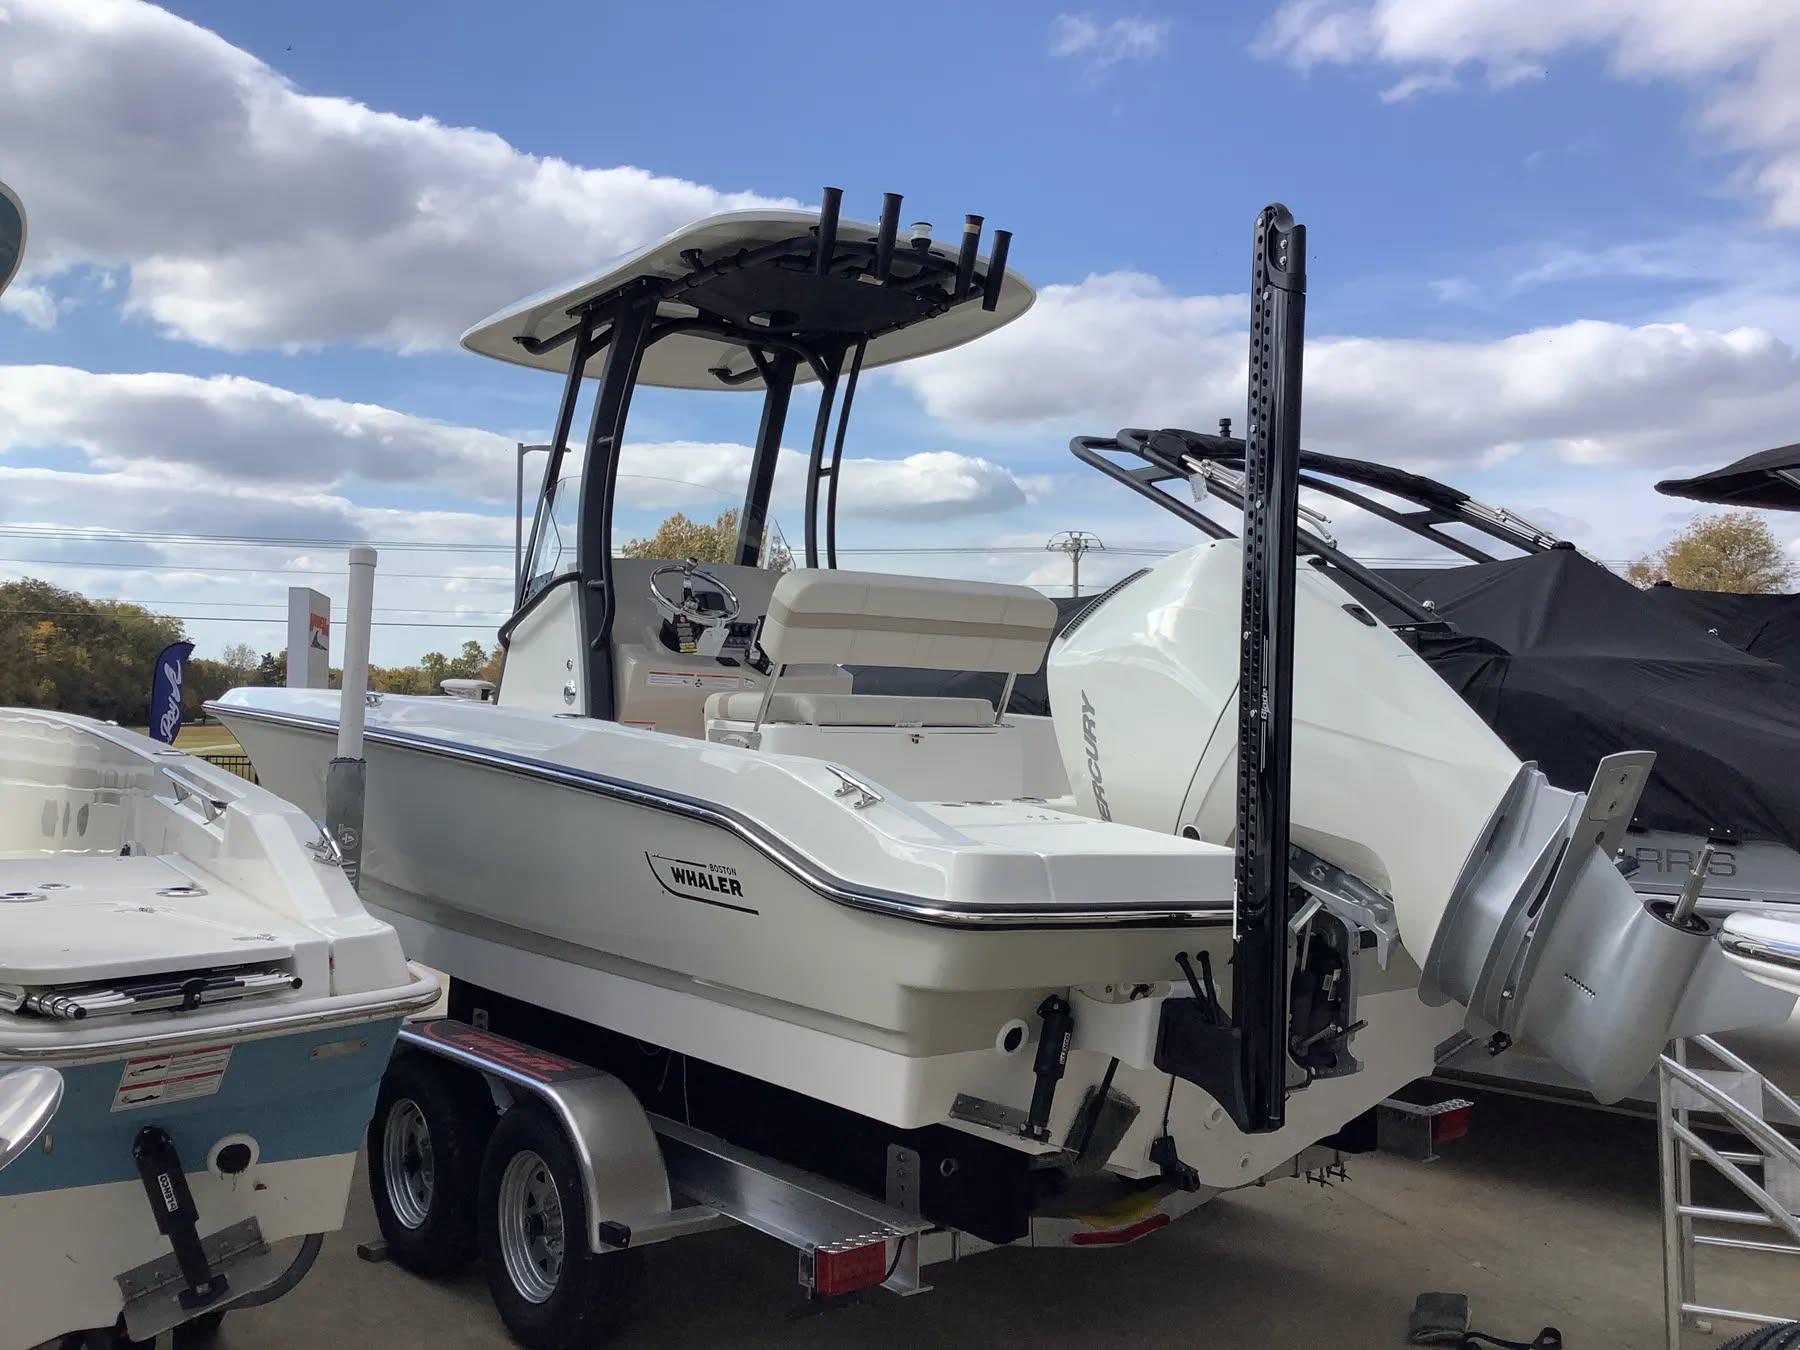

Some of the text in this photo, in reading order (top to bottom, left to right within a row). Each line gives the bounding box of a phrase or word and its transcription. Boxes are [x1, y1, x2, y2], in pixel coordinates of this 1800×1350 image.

[1260, 687, 1271, 720] Blade
[1081, 689, 1112, 823] ERCURY
[670, 866, 744, 897] WHALER
[709, 863, 737, 876] BOSTON
[159, 1175, 175, 1204] LENCO
